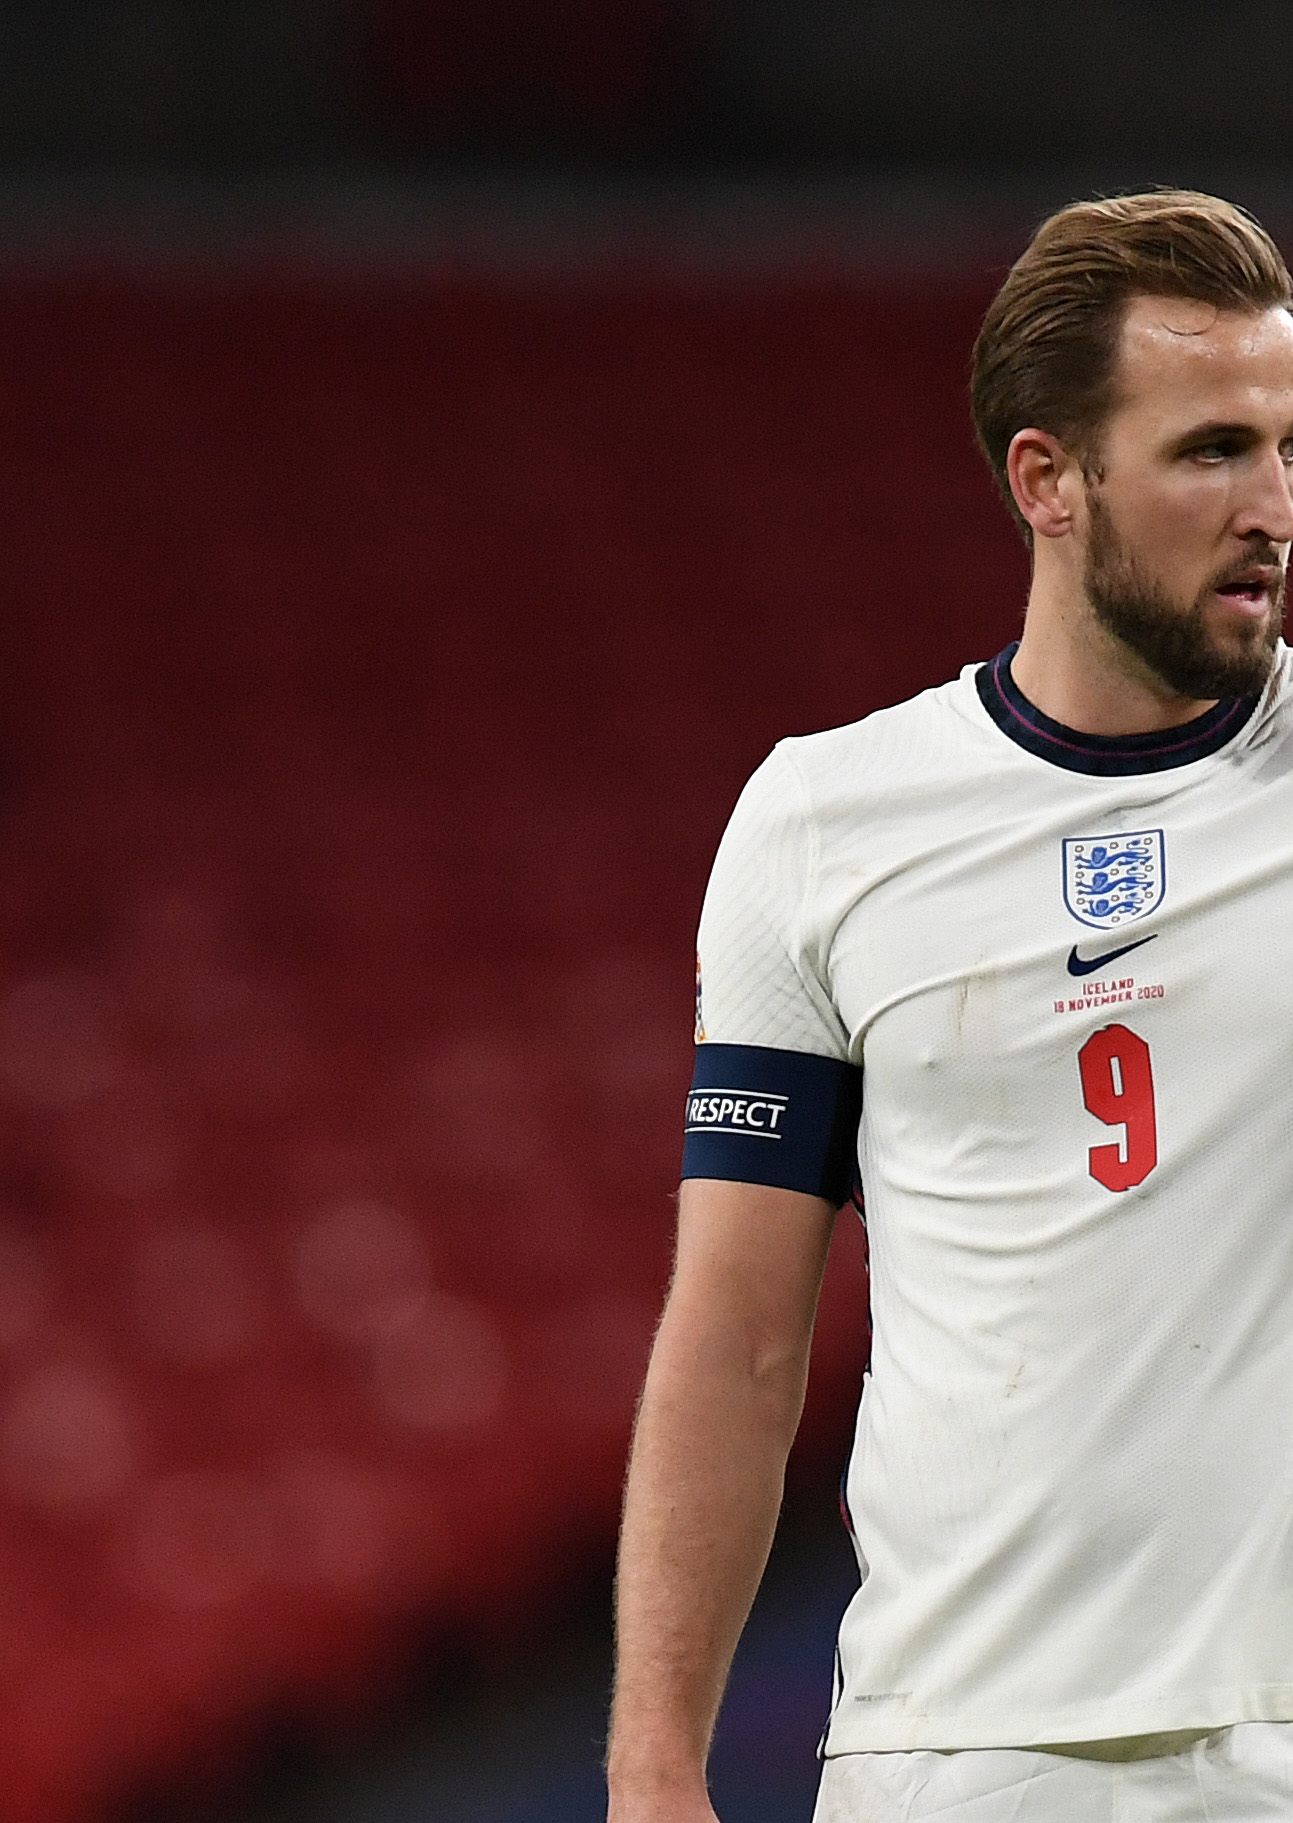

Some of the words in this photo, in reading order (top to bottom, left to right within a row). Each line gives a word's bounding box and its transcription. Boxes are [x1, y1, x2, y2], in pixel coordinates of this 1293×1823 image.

[1053, 1001, 1065, 1014] 18
[1068, 991, 1133, 1012] NOVEMBER
[1137, 985, 1165, 1000] 2020
[1082, 978, 1135, 996] ICELAND
[689, 1097, 785, 1128] RESPECT
[1077, 1023, 1158, 1193] 9
